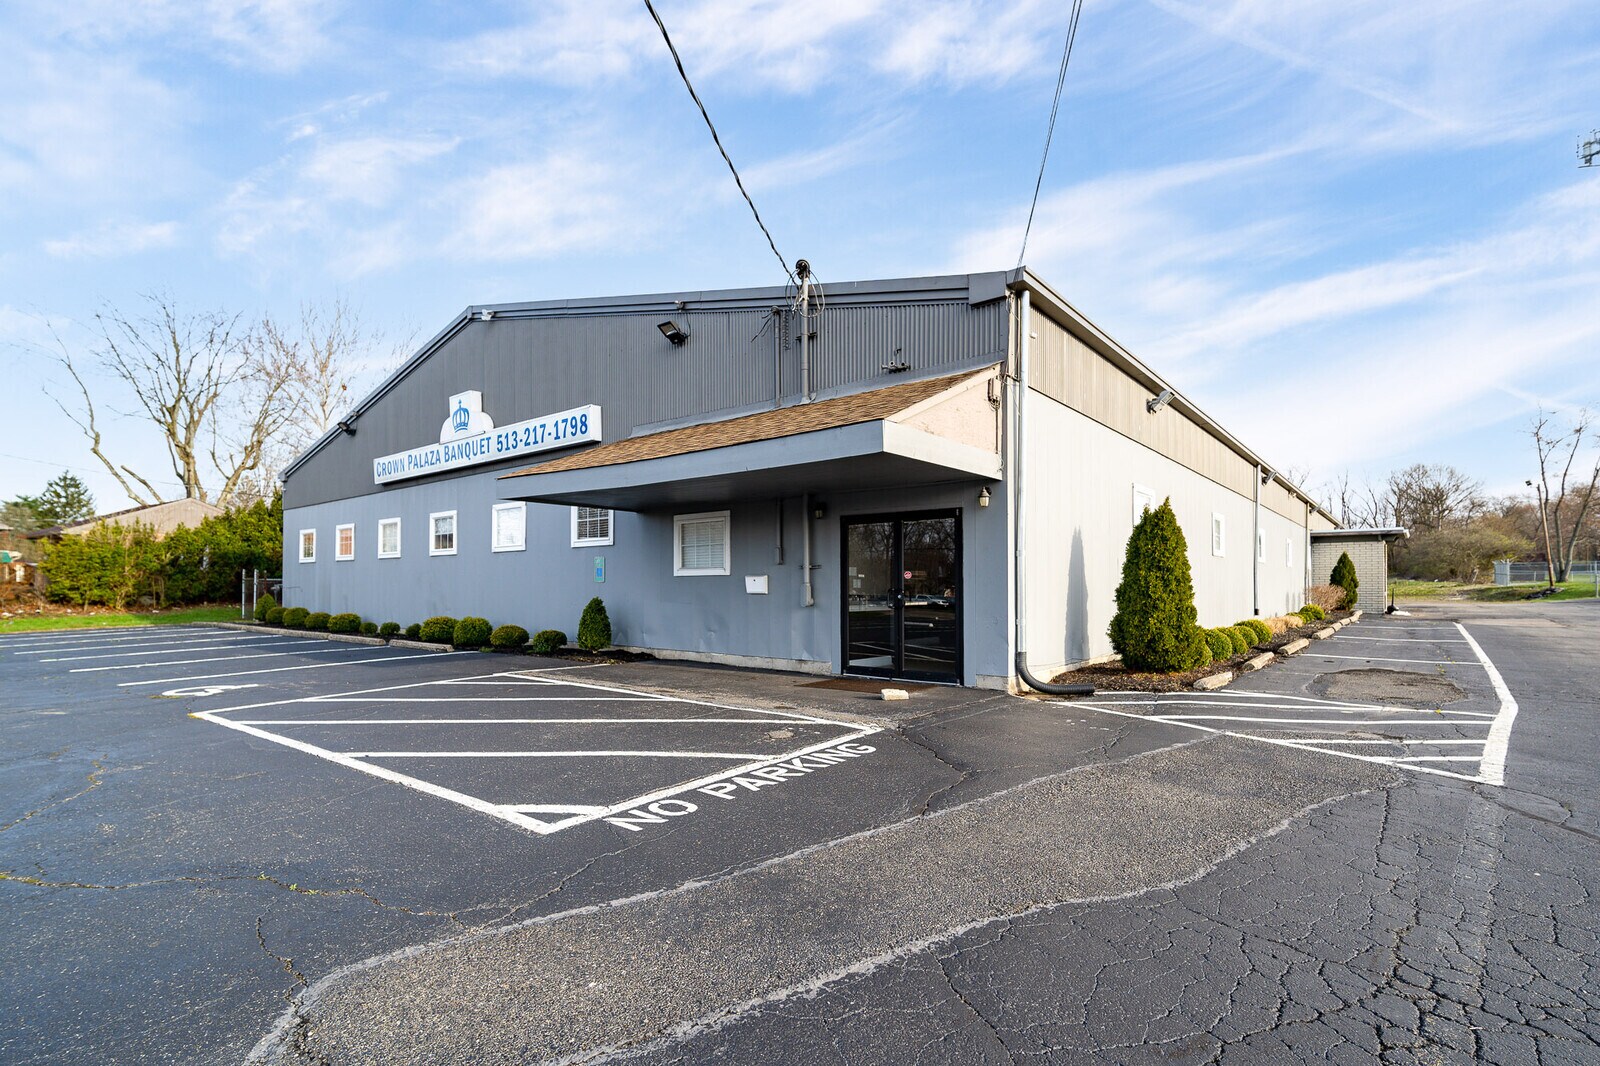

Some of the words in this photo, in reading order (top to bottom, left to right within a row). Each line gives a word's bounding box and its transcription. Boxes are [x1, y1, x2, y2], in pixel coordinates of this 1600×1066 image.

[376, 458, 405, 477] CROWN
[407, 449, 441, 471] PALAZA
[444, 436, 491, 462] BANQUET
[496, 413, 588, 453] 513-217-1798
[602, 800, 698, 832] NO
[697, 743, 876, 800] PARKING
